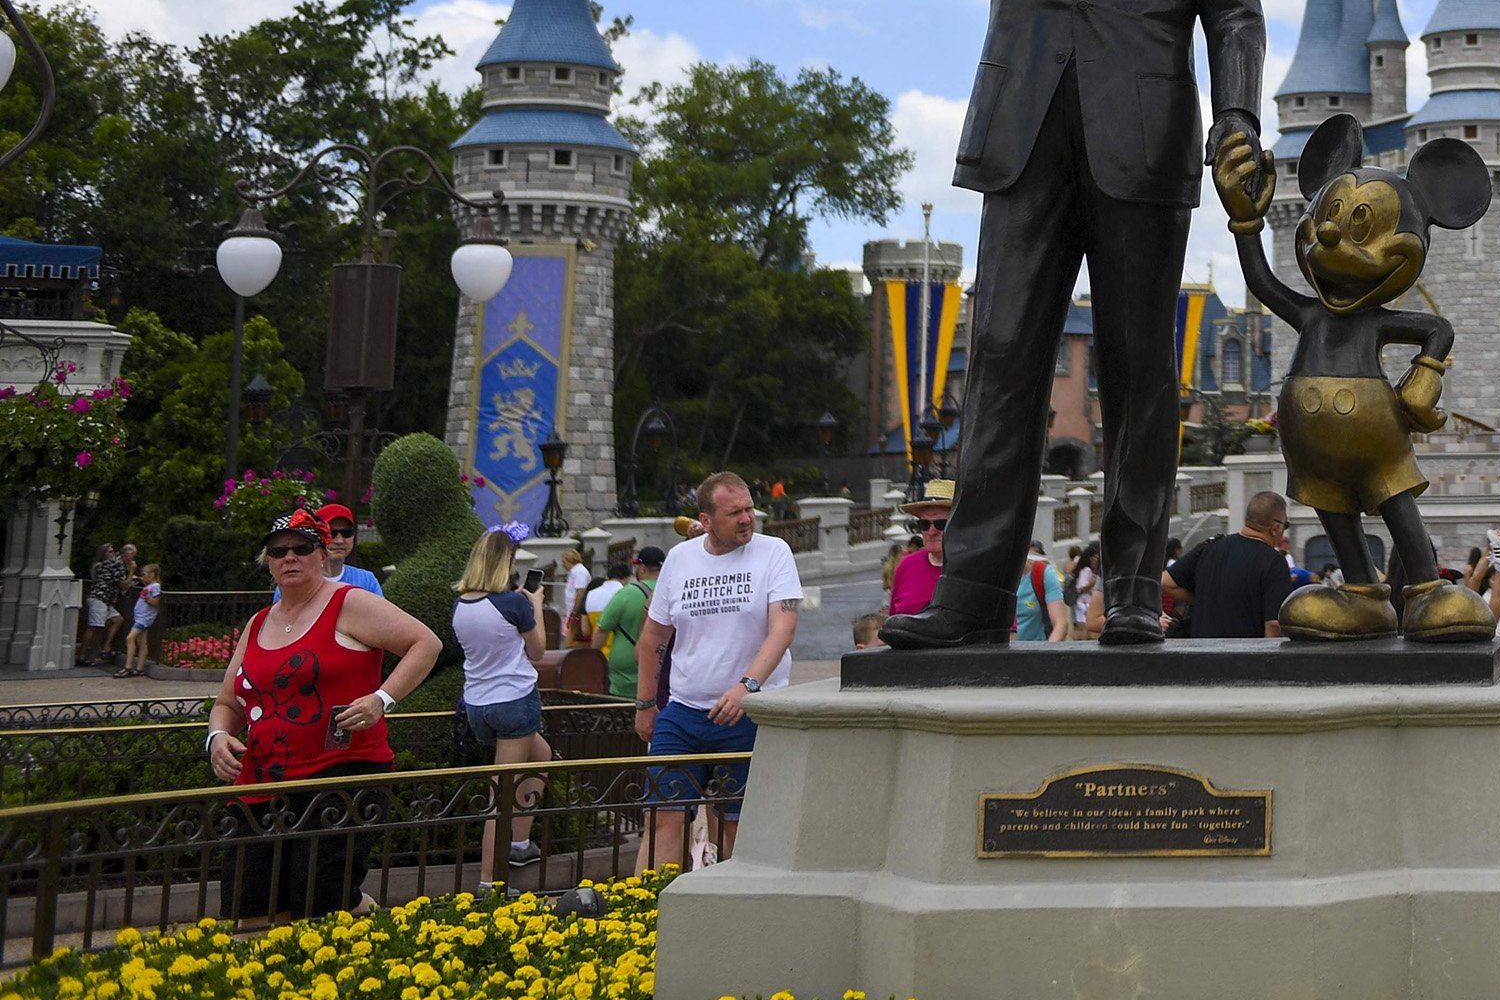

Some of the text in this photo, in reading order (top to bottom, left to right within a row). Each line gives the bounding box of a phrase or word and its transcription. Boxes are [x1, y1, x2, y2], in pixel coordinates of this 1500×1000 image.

[683, 572, 752, 590] ABERCROMBIE
[681, 584, 753, 601] AND FITCH CO.
[681, 596, 751, 610] GUARANTEED ORIGINAL
[690, 605, 741, 617] OUTDOOR GOODS
[1033, 808, 1069, 818] believe
[1073, 808, 1083, 817] in
[1145, 807, 1178, 818] family
[1181, 807, 1205, 818] park
[1209, 807, 1241, 816] where
[999, 823, 1039, 832] parents
[1042, 822, 1061, 831] and
[1064, 821, 1108, 831] children
[1112, 821, 1140, 830] could
[1144, 821, 1167, 830] have
[1171, 820, 1188, 829] fun
